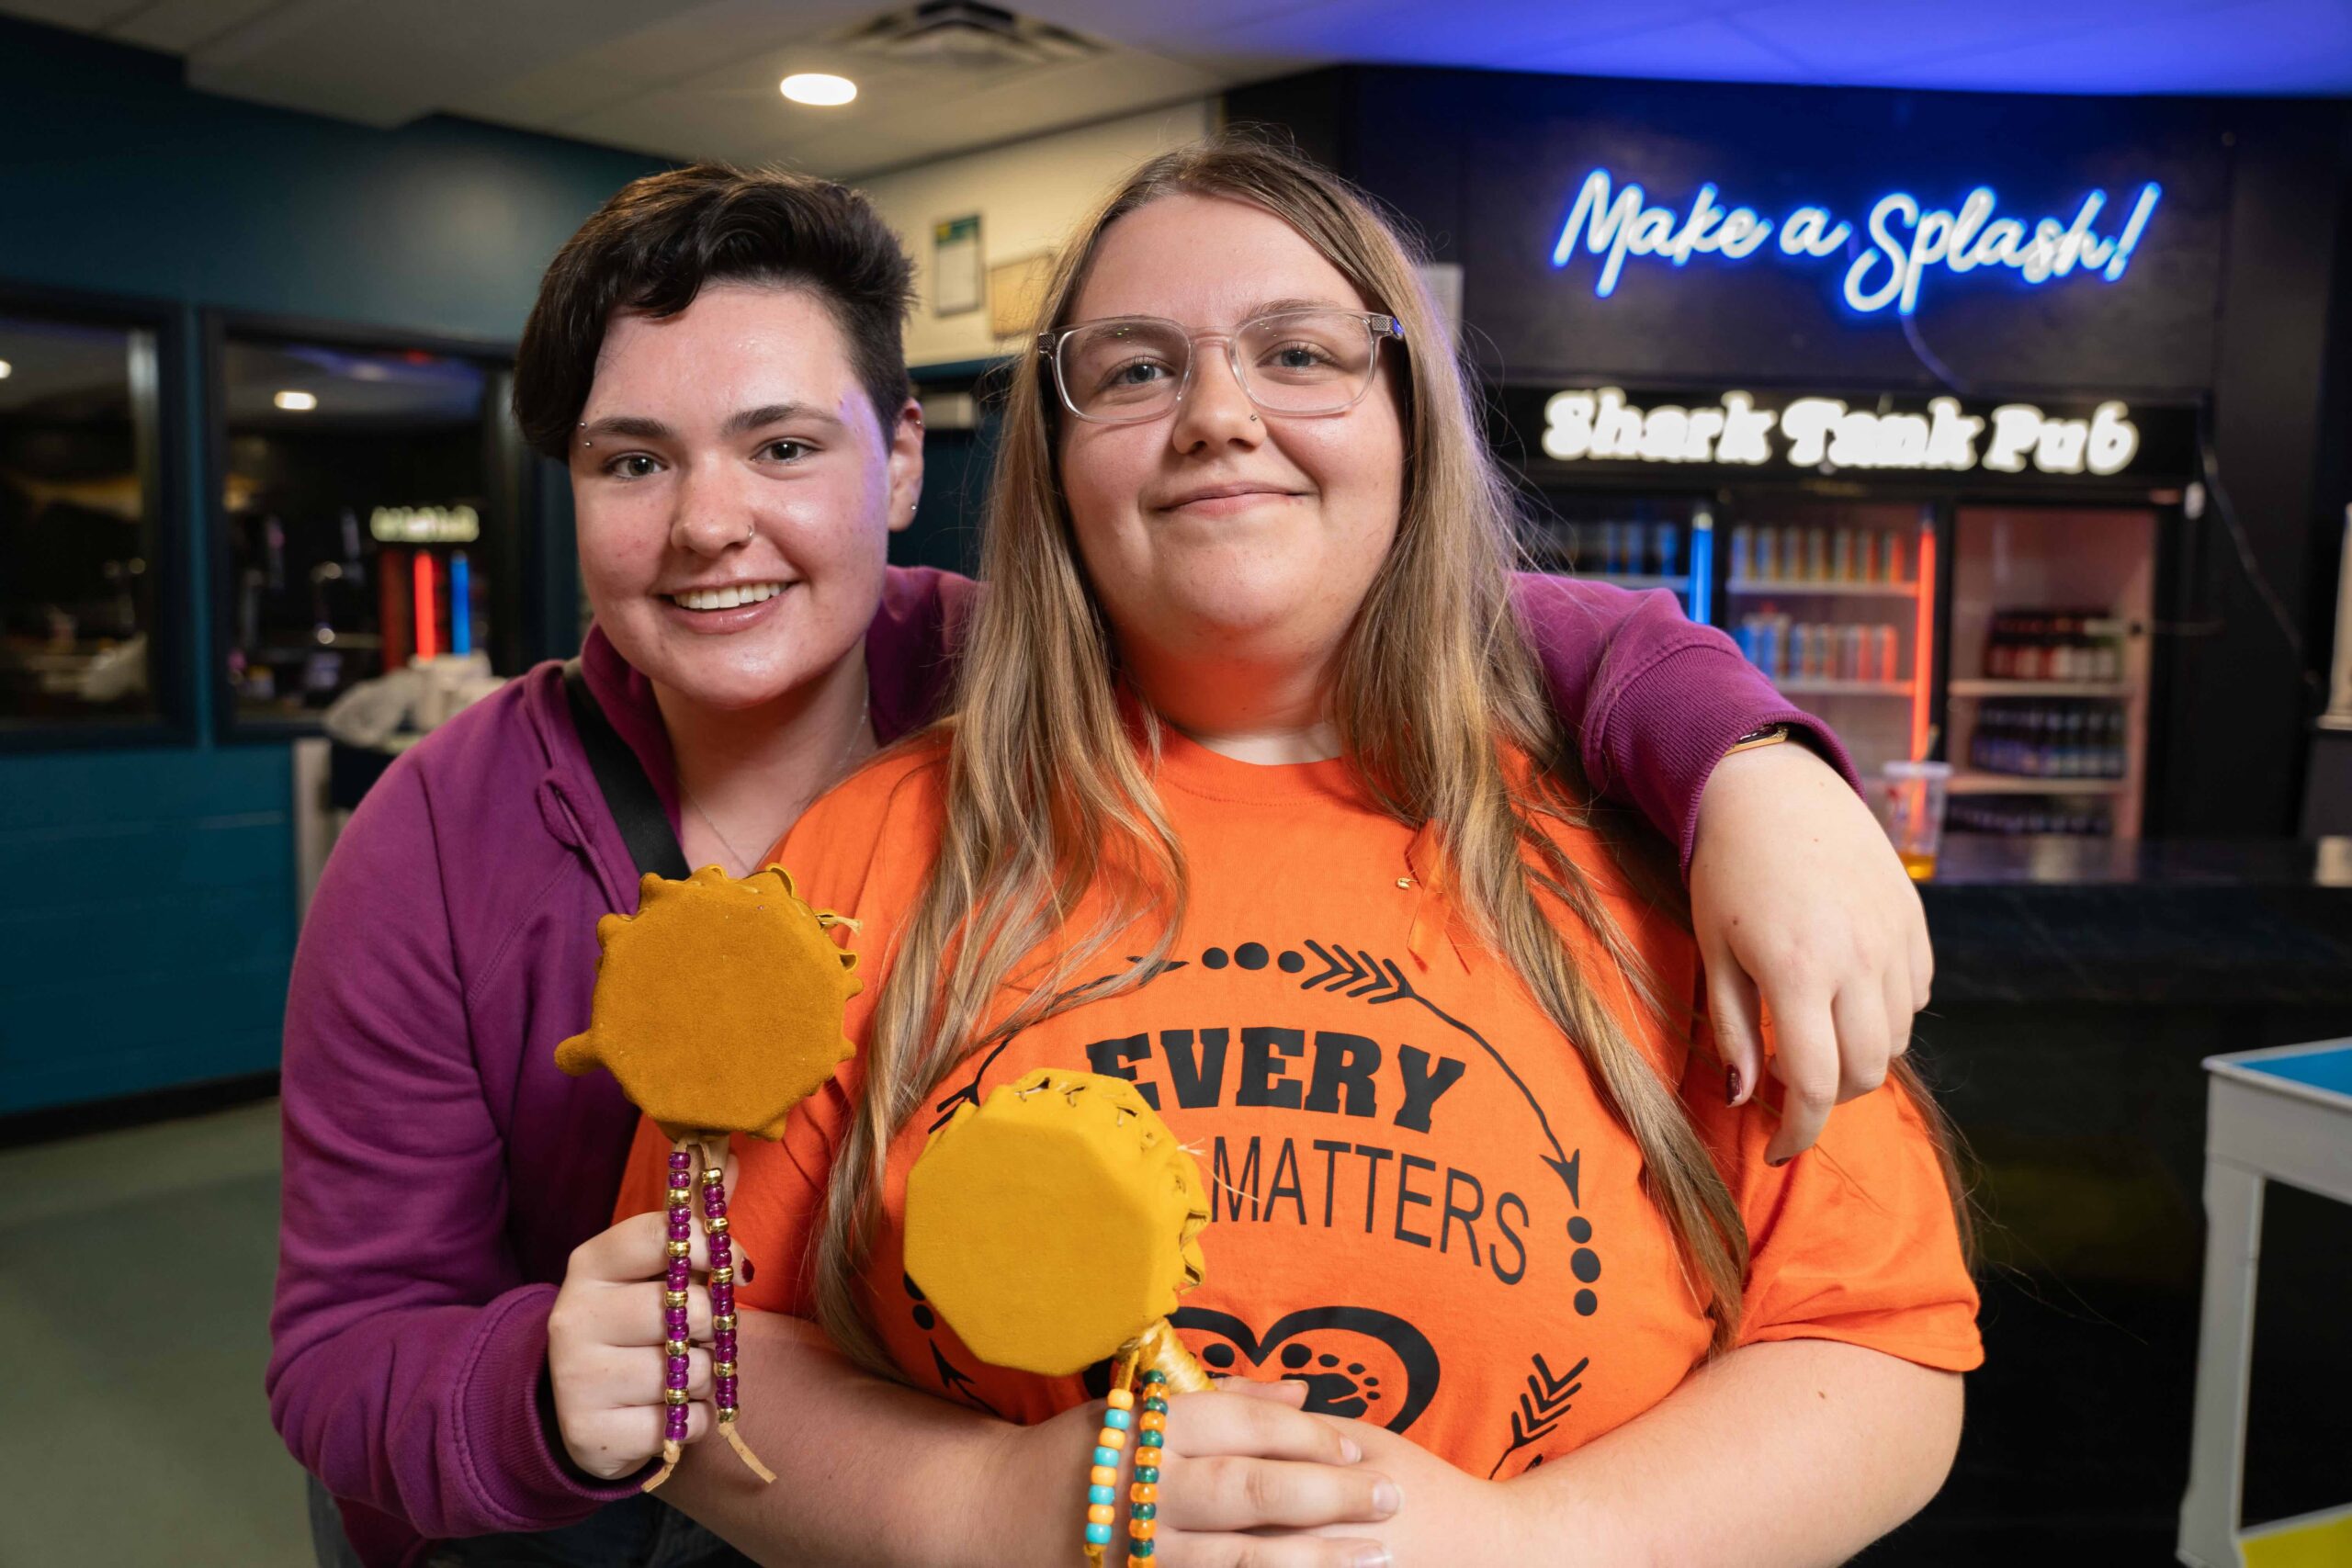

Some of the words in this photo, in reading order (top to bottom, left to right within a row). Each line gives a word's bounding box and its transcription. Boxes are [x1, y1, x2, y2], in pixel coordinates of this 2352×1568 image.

[1553, 168, 1774, 297] Make
[1780, 207, 1851, 256] a
[1844, 182, 2161, 314] Splash!
[1543, 387, 1777, 463] Shark
[1781, 396, 1984, 470] Tank
[1983, 400, 2138, 475] Pub
[1086, 1026, 1466, 1134] EVERY
[1210, 1135, 1529, 1286] MATTERS
